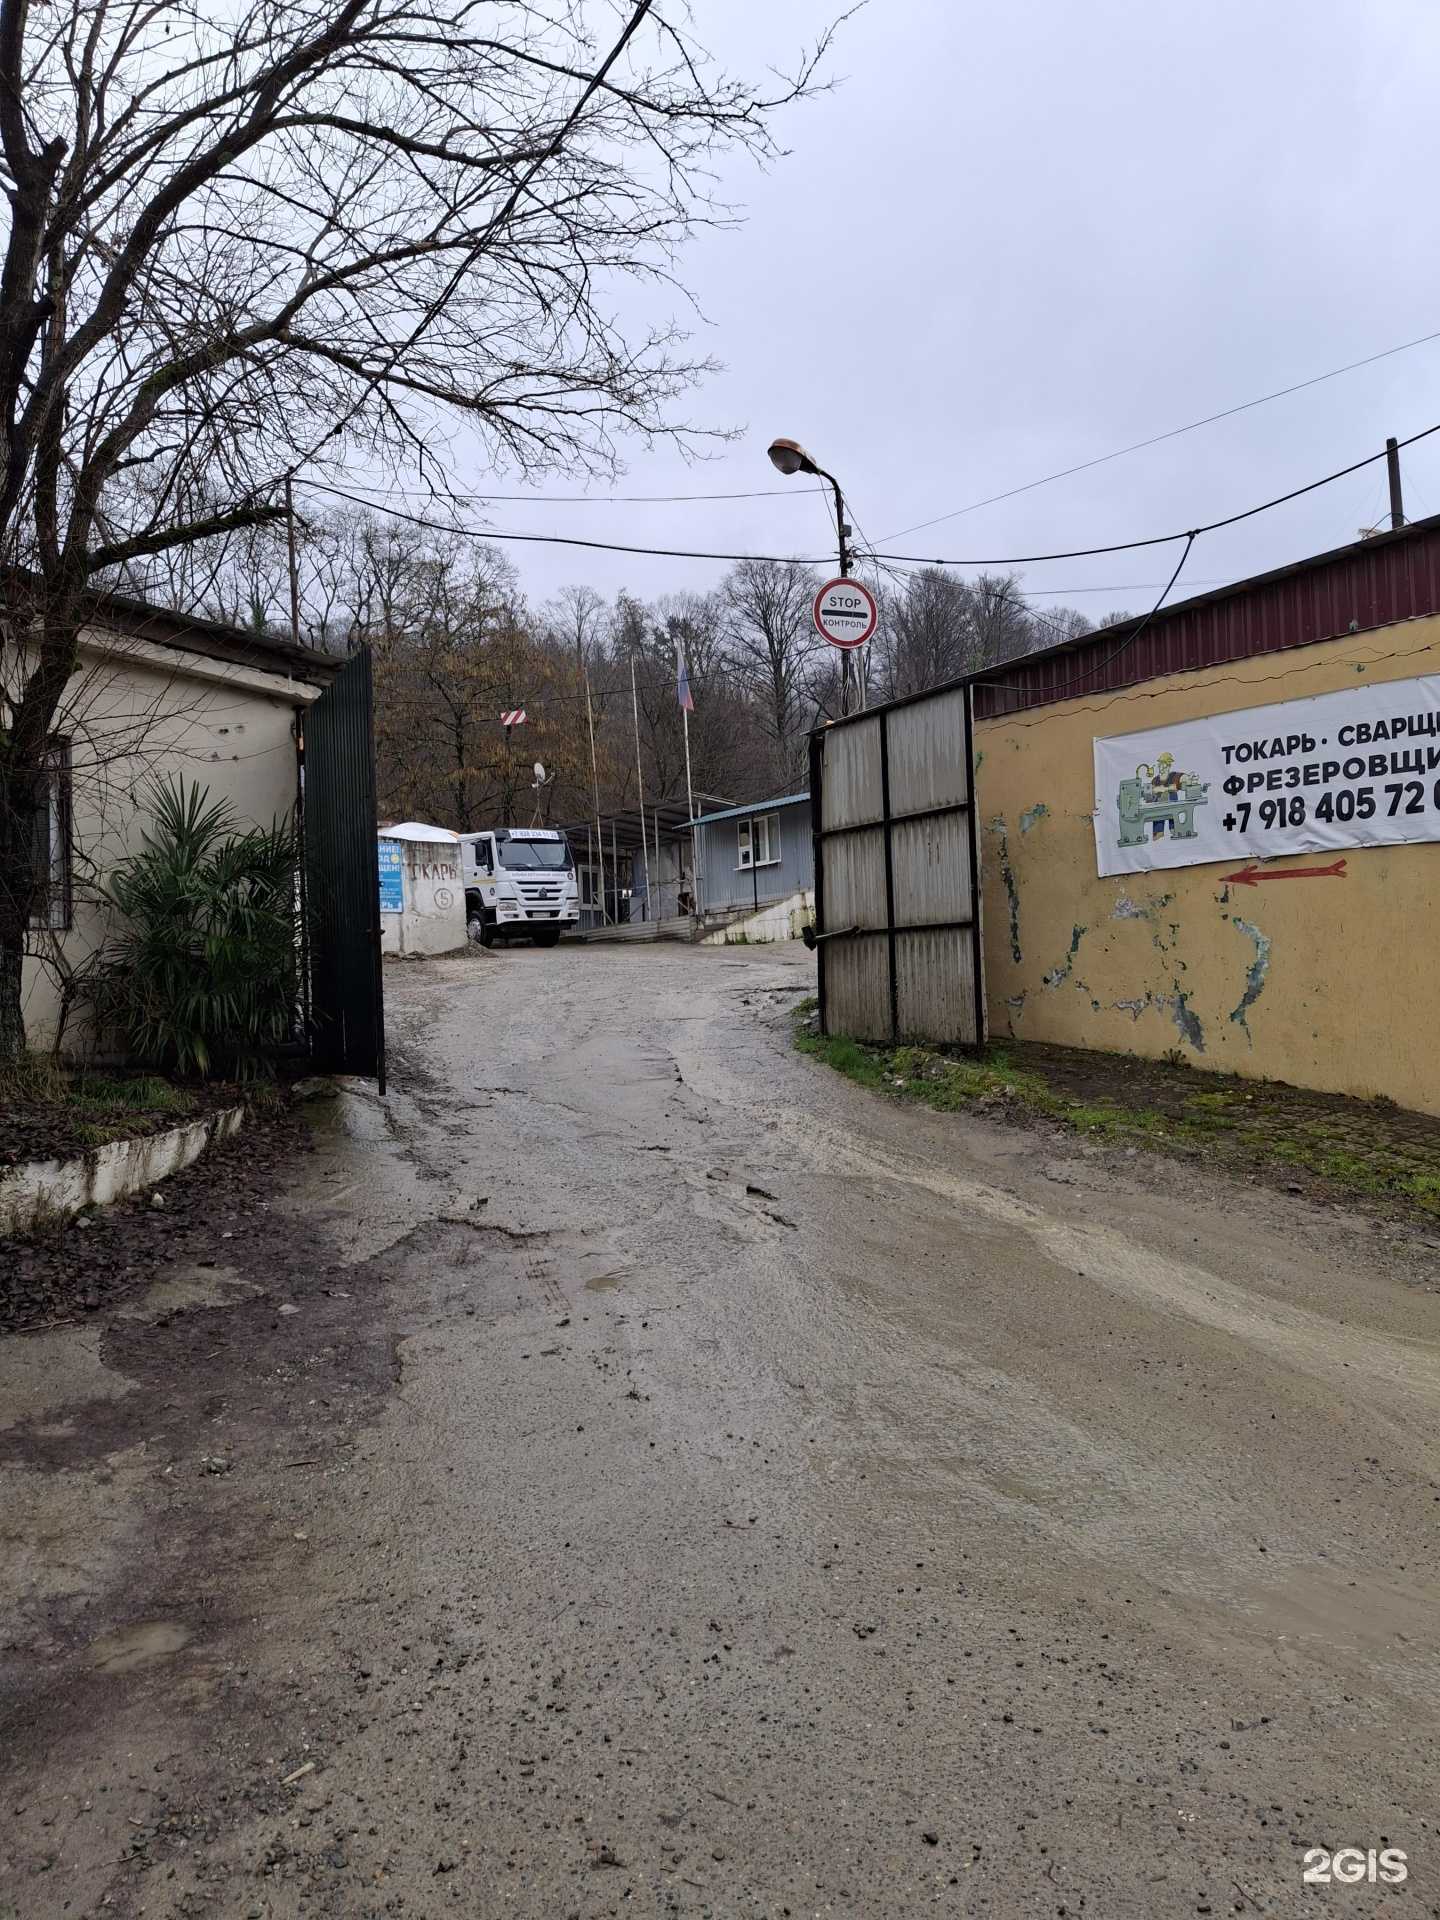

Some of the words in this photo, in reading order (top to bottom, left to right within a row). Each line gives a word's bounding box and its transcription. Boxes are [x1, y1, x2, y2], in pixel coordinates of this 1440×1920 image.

[830, 597, 861, 609] STOP
[823, 619, 867, 630] КОНТРОЛЬ
[1221, 733, 1316, 765] ТОКАРЬ
[1337, 711, 1440, 748] СВАРЩ
[1222, 803, 1252, 833] +7
[1259, 796, 1306, 830] 918
[1315, 786, 1376, 823] 405
[1384, 780, 1425, 817] 72
